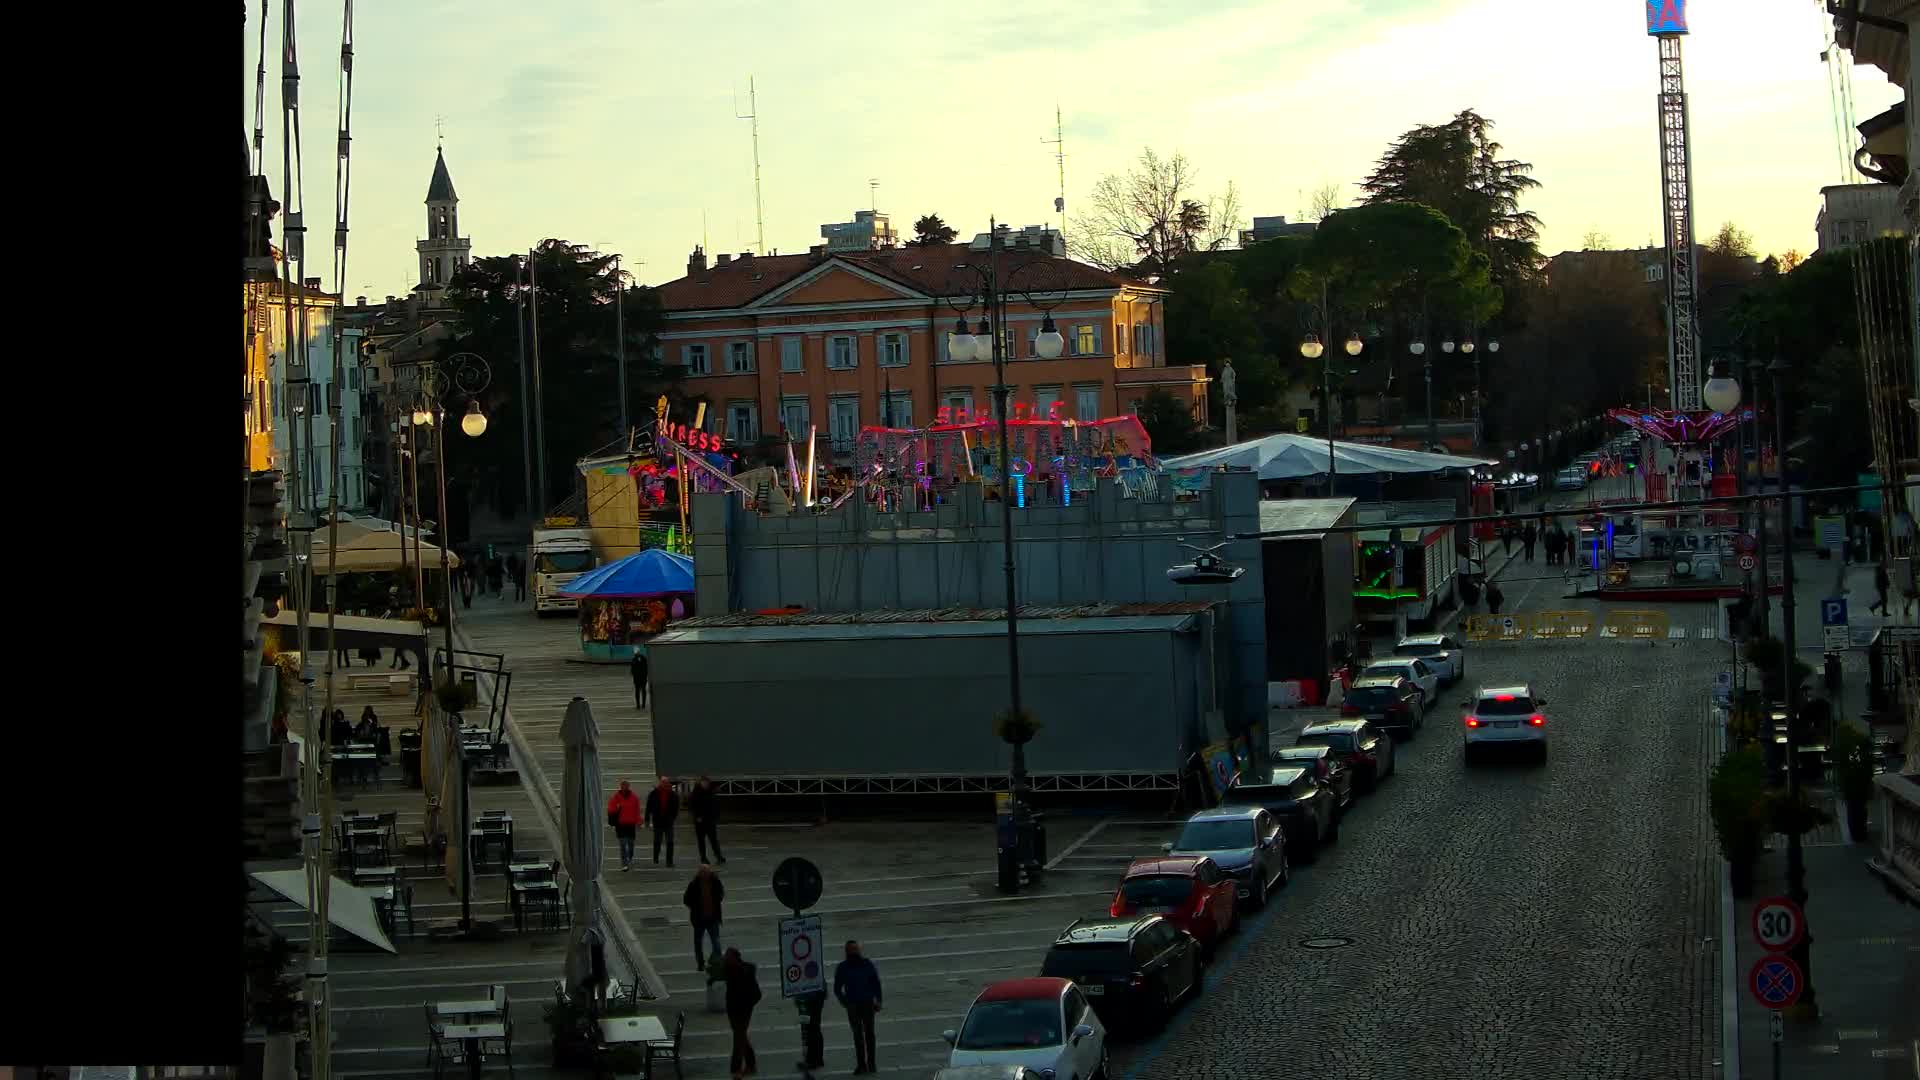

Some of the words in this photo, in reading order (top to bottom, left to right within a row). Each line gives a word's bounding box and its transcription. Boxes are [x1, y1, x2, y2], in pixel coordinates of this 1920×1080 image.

[1742, 558, 1753, 568] 20
[1827, 603, 1841, 622] P
[1762, 911, 1791, 938] 30
